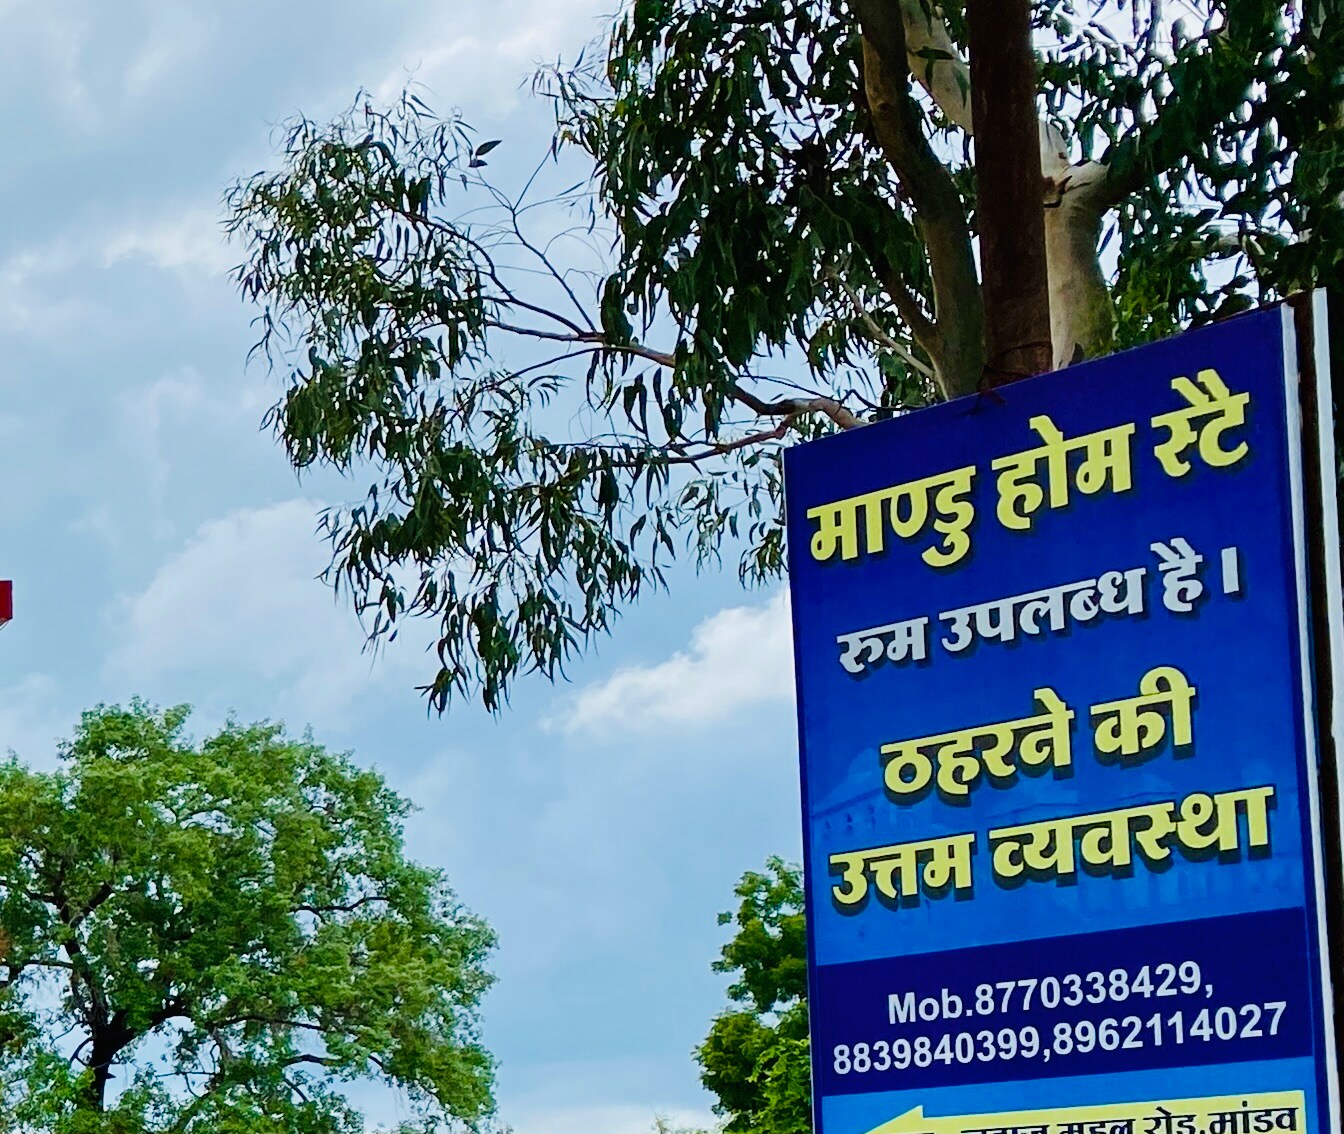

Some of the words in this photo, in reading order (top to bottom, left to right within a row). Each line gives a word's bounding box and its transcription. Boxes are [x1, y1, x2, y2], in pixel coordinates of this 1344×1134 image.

[807, 466, 976, 567] माण्डु
[991, 415, 1136, 530] होम
[1151, 369, 1250, 477] स्टै
[837, 617, 928, 674] रुम
[939, 567, 1147, 652] उपलब्ध
[881, 687, 1075, 795] ठहरने
[1090, 666, 1196, 755] की
[830, 833, 976, 905] उत्तम
[989, 786, 1275, 878] व्यवस्था
[833, 1001, 1288, 1075] 8839840399,8962114027
[888, 960, 1214, 1025] Mob.8770338429,
